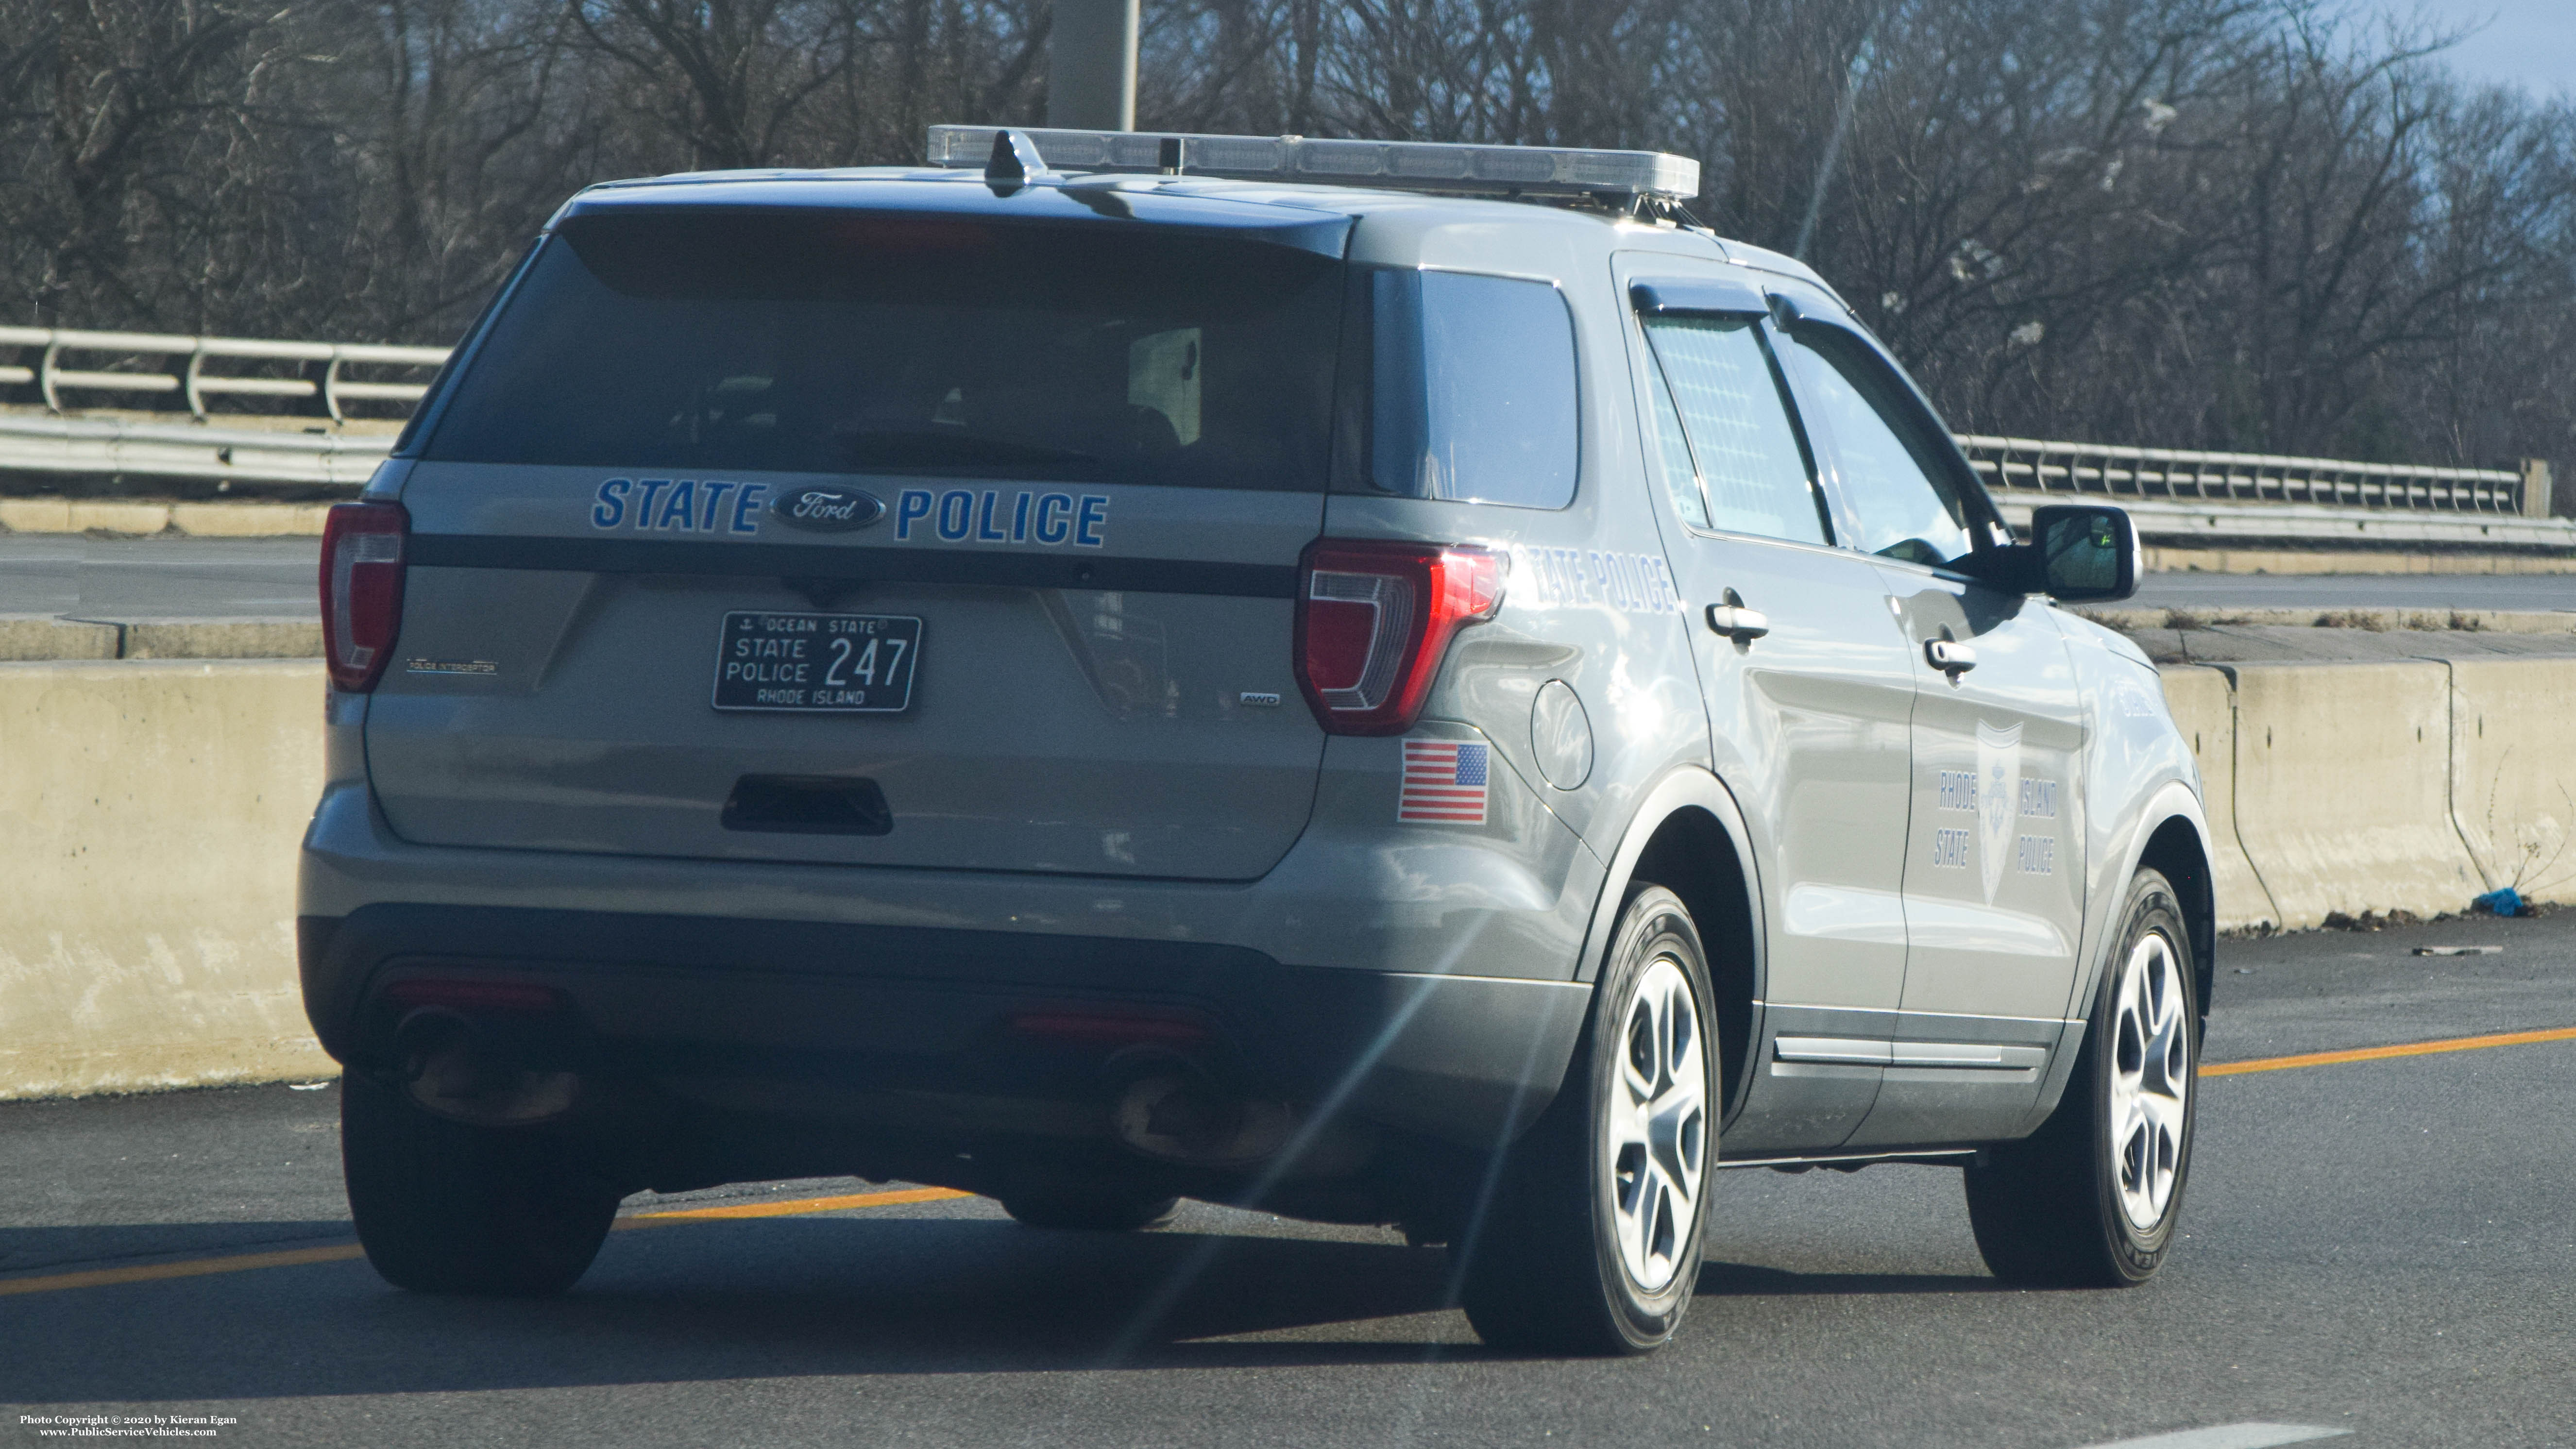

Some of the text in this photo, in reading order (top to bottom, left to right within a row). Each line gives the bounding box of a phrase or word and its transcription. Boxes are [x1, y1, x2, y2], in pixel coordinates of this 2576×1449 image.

[591, 476, 1110, 548] STATE POLICE
[793, 491, 857, 522] Ford
[1588, 549, 1679, 615] POLICE
[766, 618, 875, 634] OCEAN STATE
[735, 638, 808, 658] STATE
[825, 638, 907, 686] 247
[727, 662, 810, 682] POLICE
[757, 689, 865, 705] RHODE ISLAND
[1939, 770, 2056, 819] RHODE ISLAND
[1934, 827, 2055, 876] STATE POLICE
